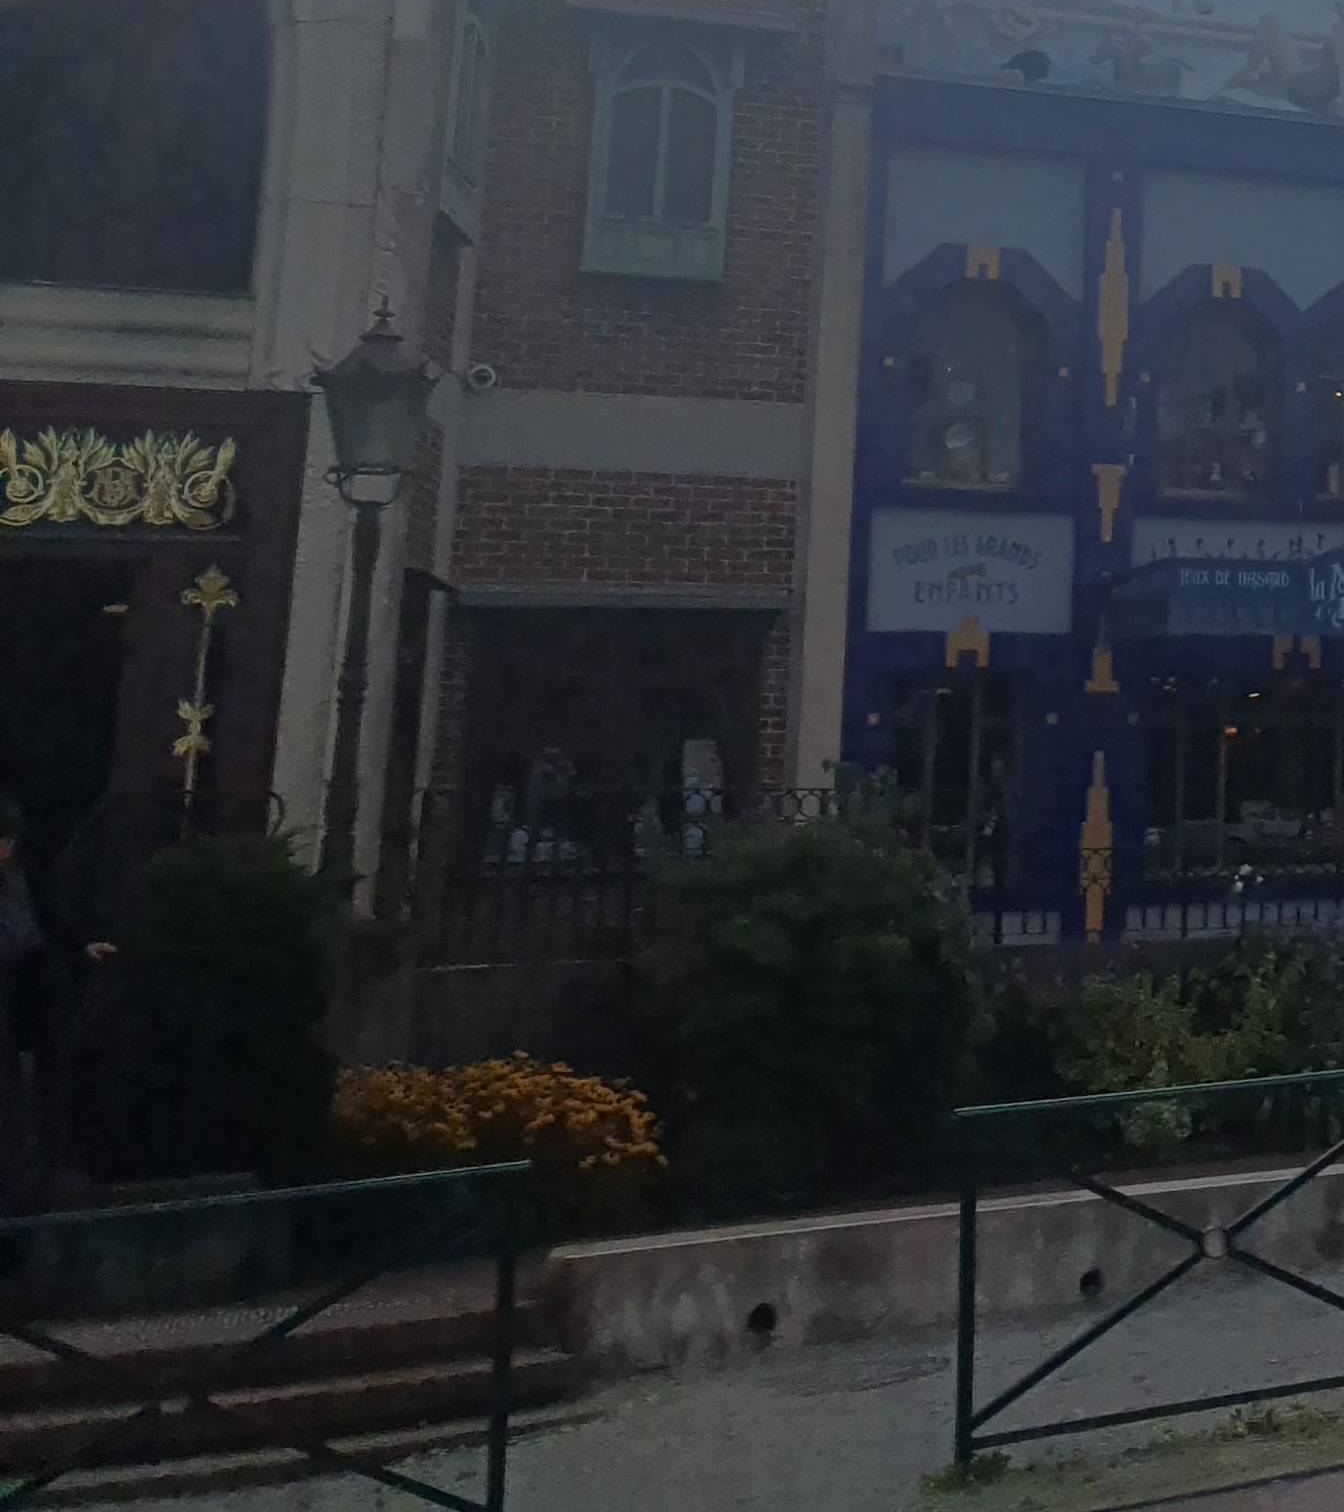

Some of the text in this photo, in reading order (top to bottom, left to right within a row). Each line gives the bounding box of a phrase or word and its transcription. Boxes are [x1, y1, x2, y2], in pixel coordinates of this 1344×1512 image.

[944, 534, 970, 557] LES
[1180, 569, 1210, 587] JEUX
[1214, 569, 1231, 586] DE
[914, 580, 1019, 605] ENFANTS
